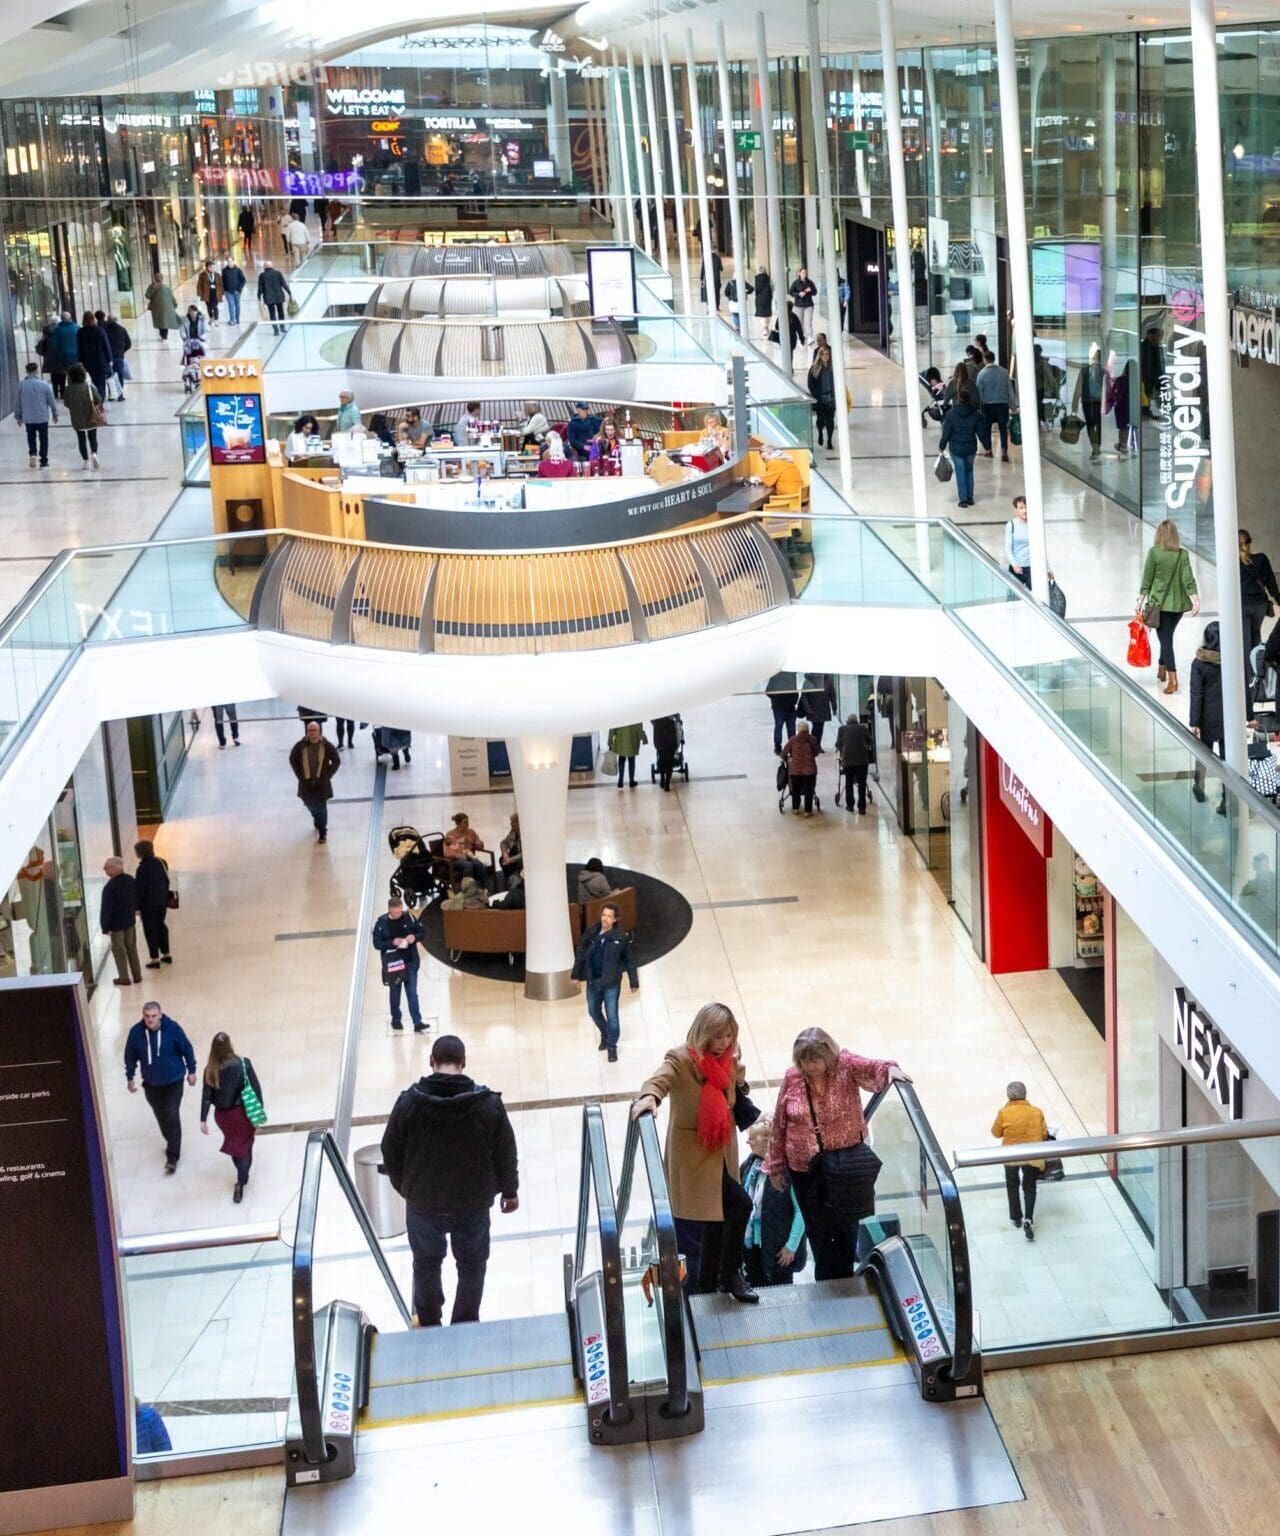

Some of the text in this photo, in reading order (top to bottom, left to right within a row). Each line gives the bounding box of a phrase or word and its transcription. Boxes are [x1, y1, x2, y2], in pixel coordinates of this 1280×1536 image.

[326, 89, 405, 103] WELCOME
[344, 105, 390, 115] LET'S EAT
[424, 117, 477, 129] TORTILLA
[203, 364, 258, 378] COSTA
[664, 490, 691, 507] HEART
[697, 483, 712, 497] SOUL
[1173, 987, 1249, 1120] NEXT
[6, 1164, 45, 1172] restaurants
[20, 1172, 33, 1182] golf
